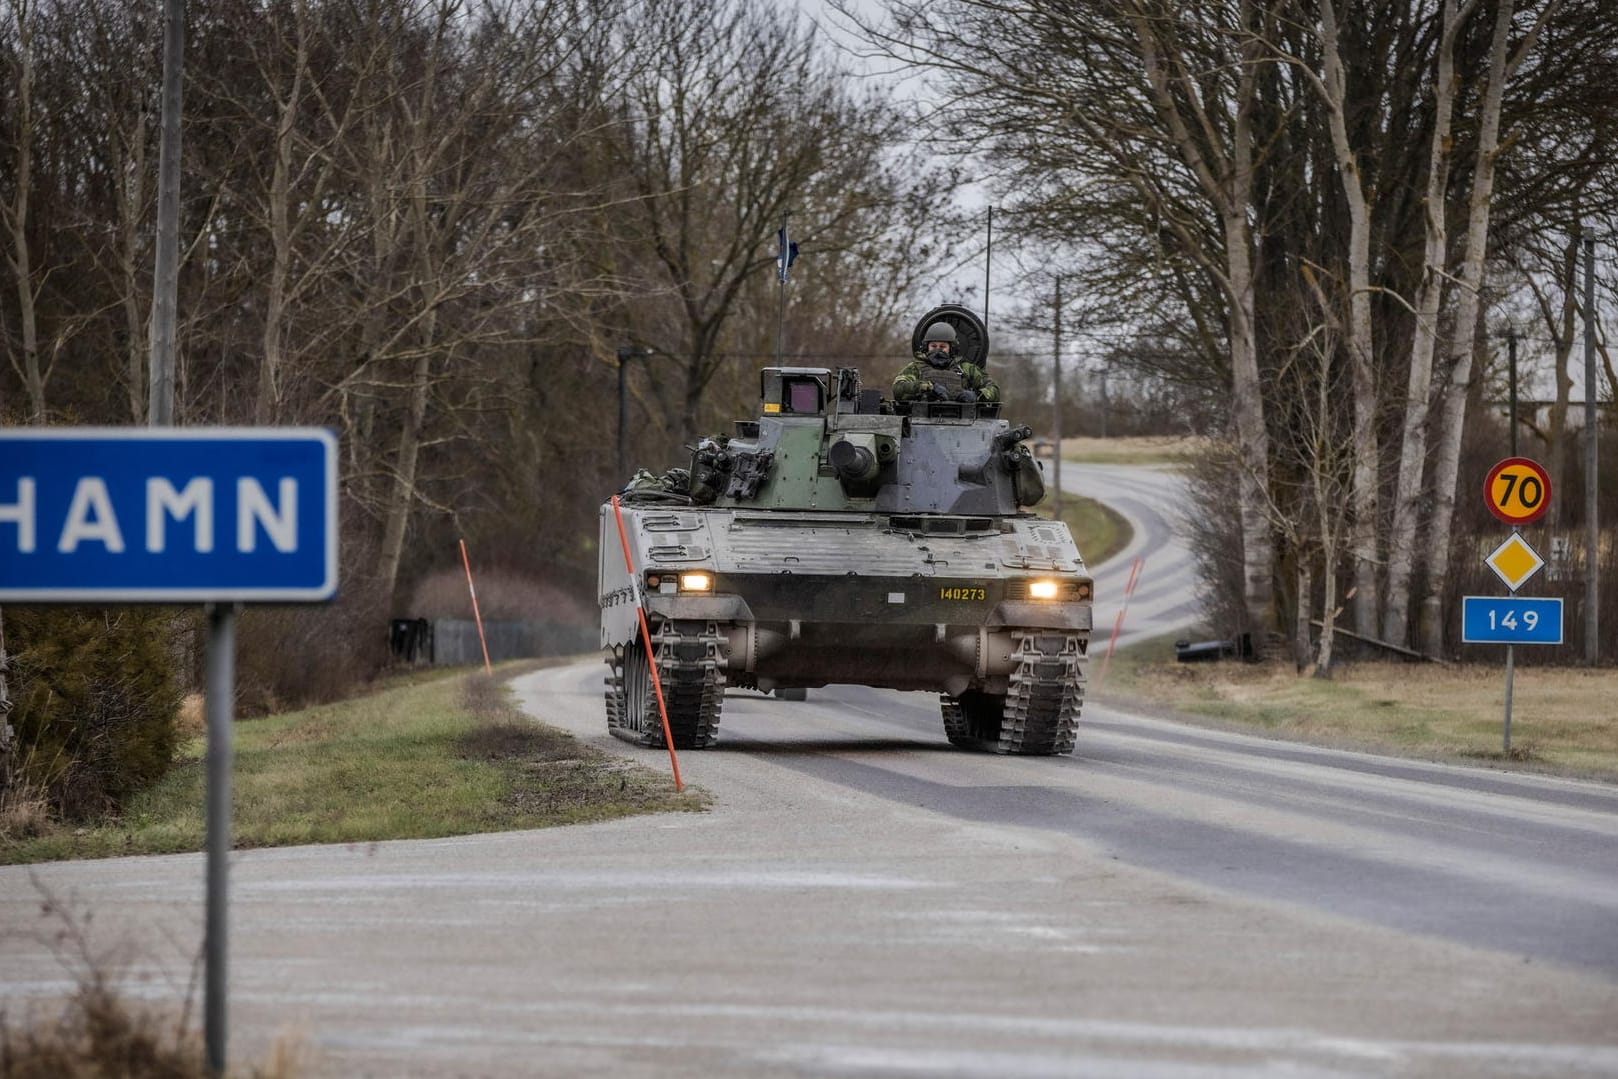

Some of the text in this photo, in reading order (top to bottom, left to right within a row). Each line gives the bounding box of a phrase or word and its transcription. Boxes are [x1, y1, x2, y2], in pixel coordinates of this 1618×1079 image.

[1500, 474, 1542, 508] 70
[940, 587, 985, 600] 140273
[1488, 609, 1539, 631] 149
